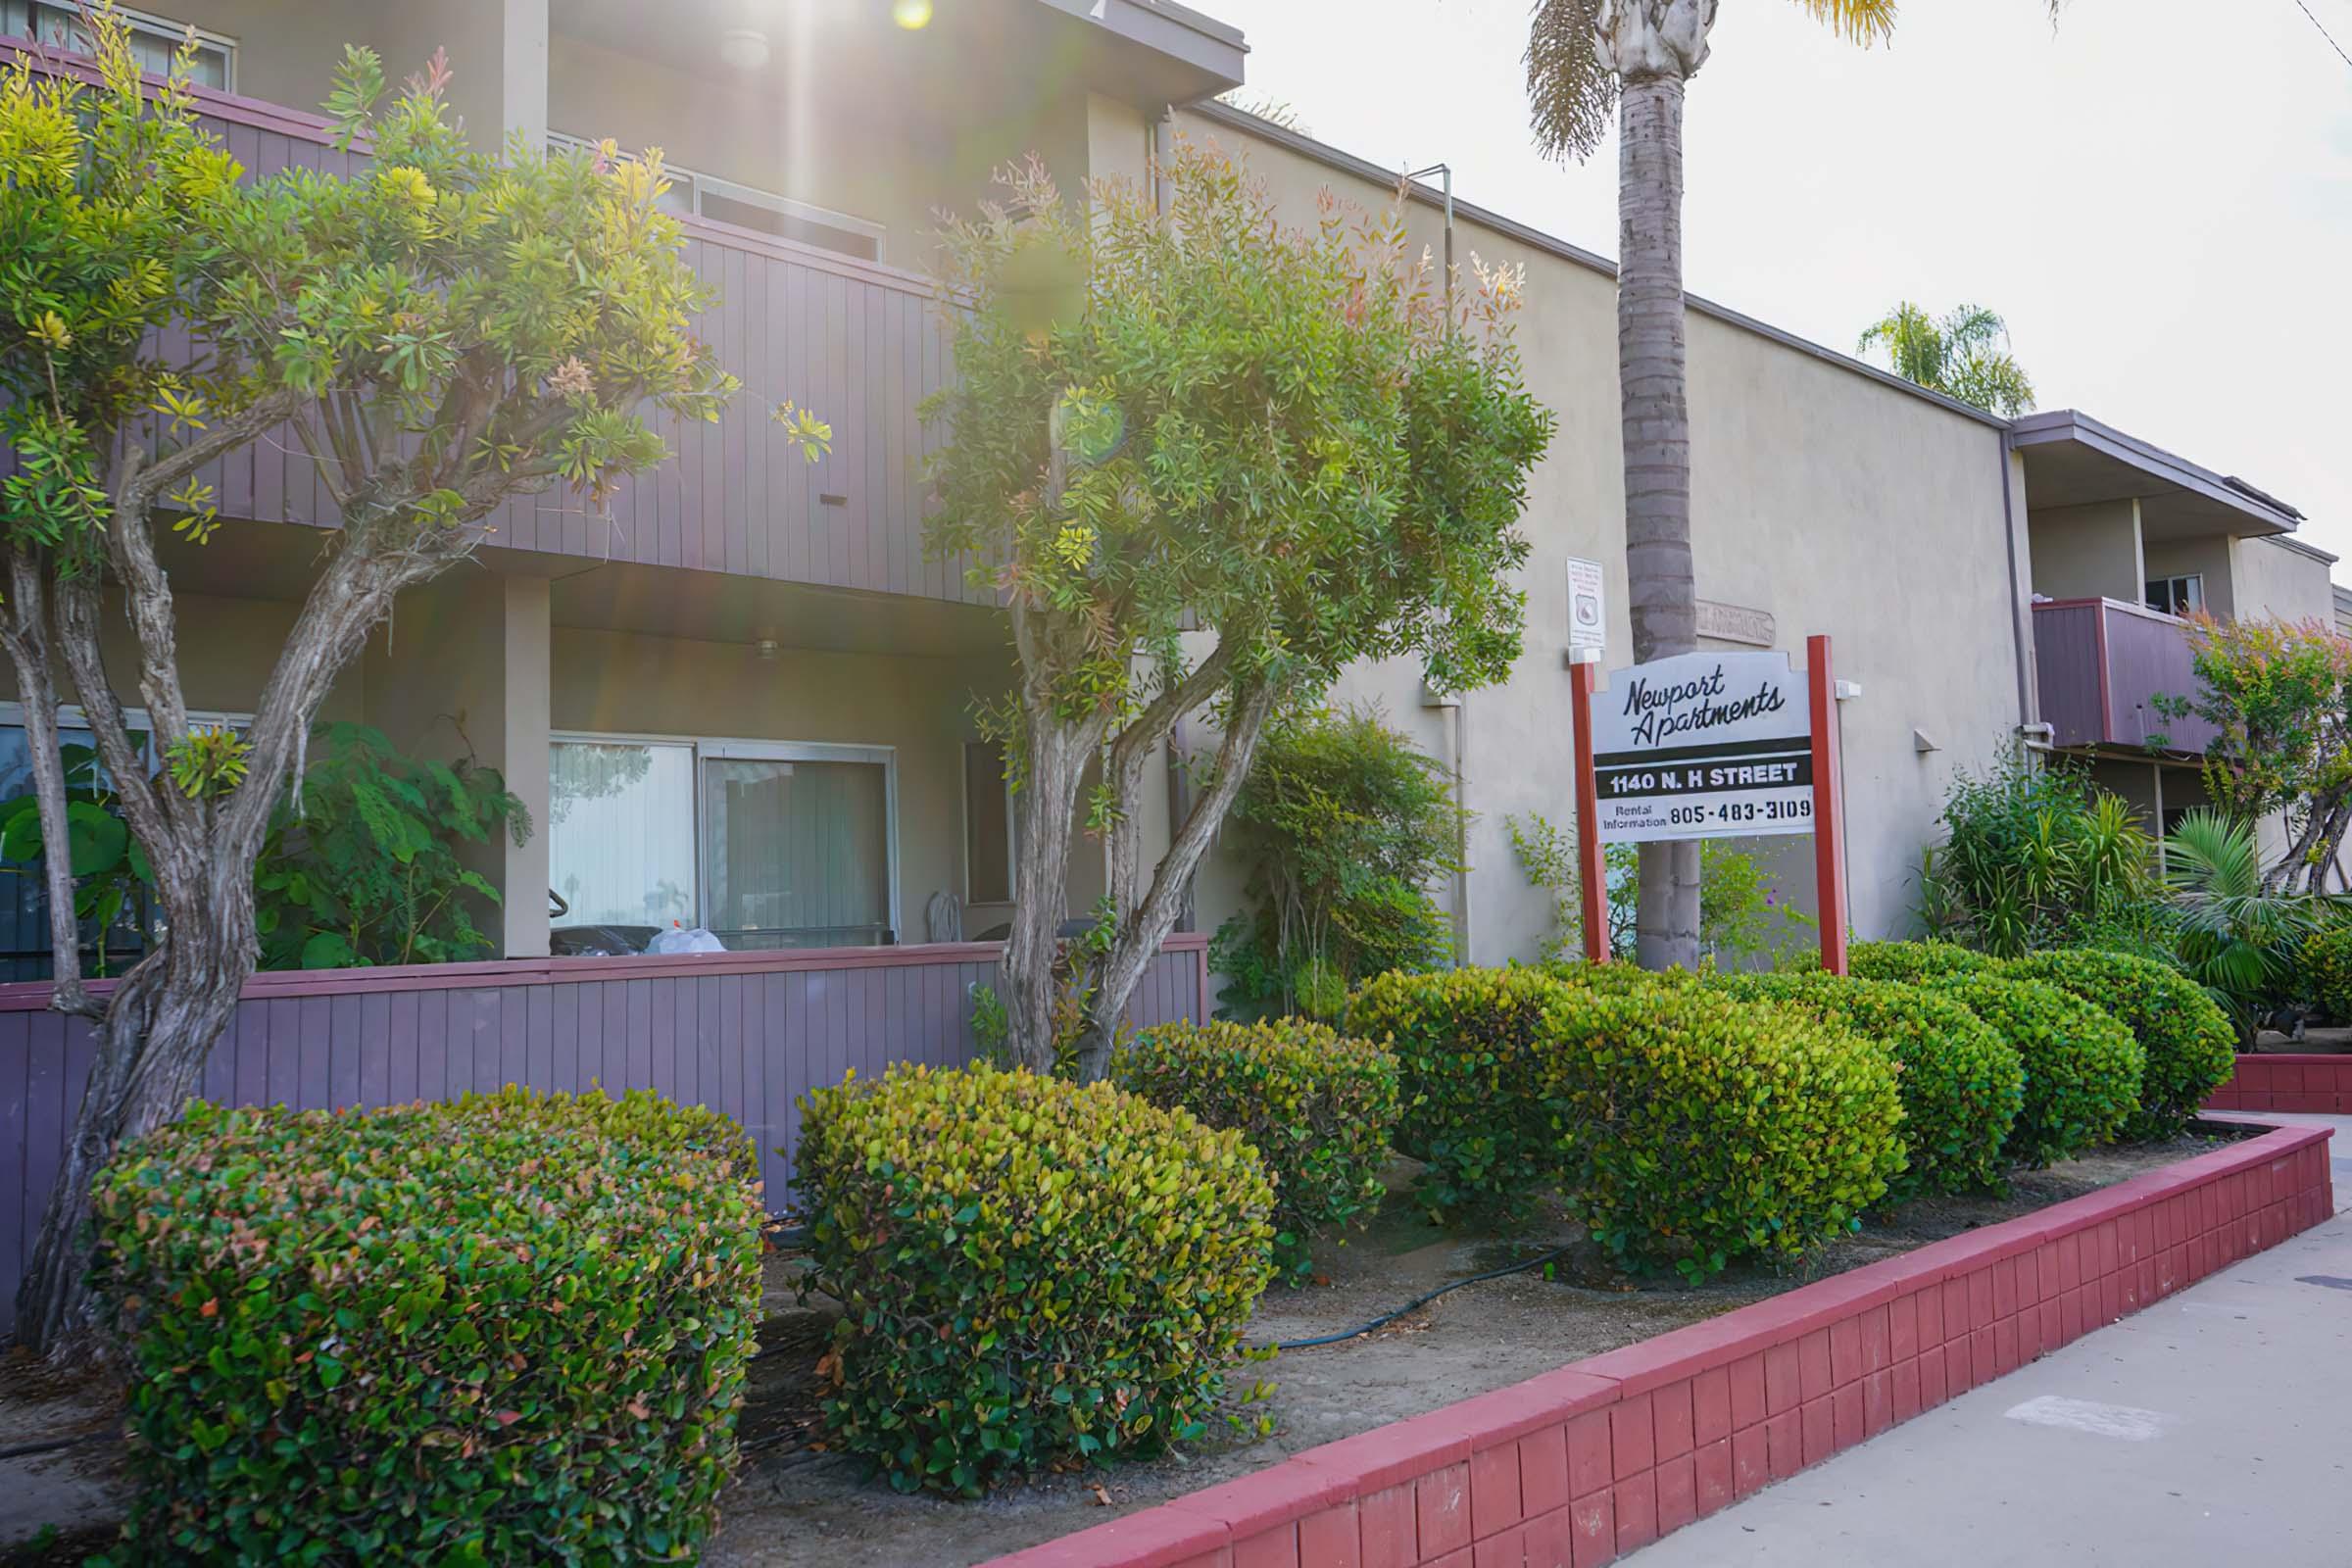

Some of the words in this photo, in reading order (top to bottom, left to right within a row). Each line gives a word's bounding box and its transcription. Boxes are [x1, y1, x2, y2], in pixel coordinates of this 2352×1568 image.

[1623, 663, 1725, 715] Newport
[1631, 681, 1786, 747] Apartments
[1611, 773, 1654, 793] 1140
[1661, 772, 1682, 790] N.
[1688, 770, 1702, 788] H
[1709, 762, 1797, 785] STREET
[1603, 817, 1667, 829] Information
[1615, 805, 1652, 816] Rental
[1670, 800, 1811, 824] 805-483-3109
